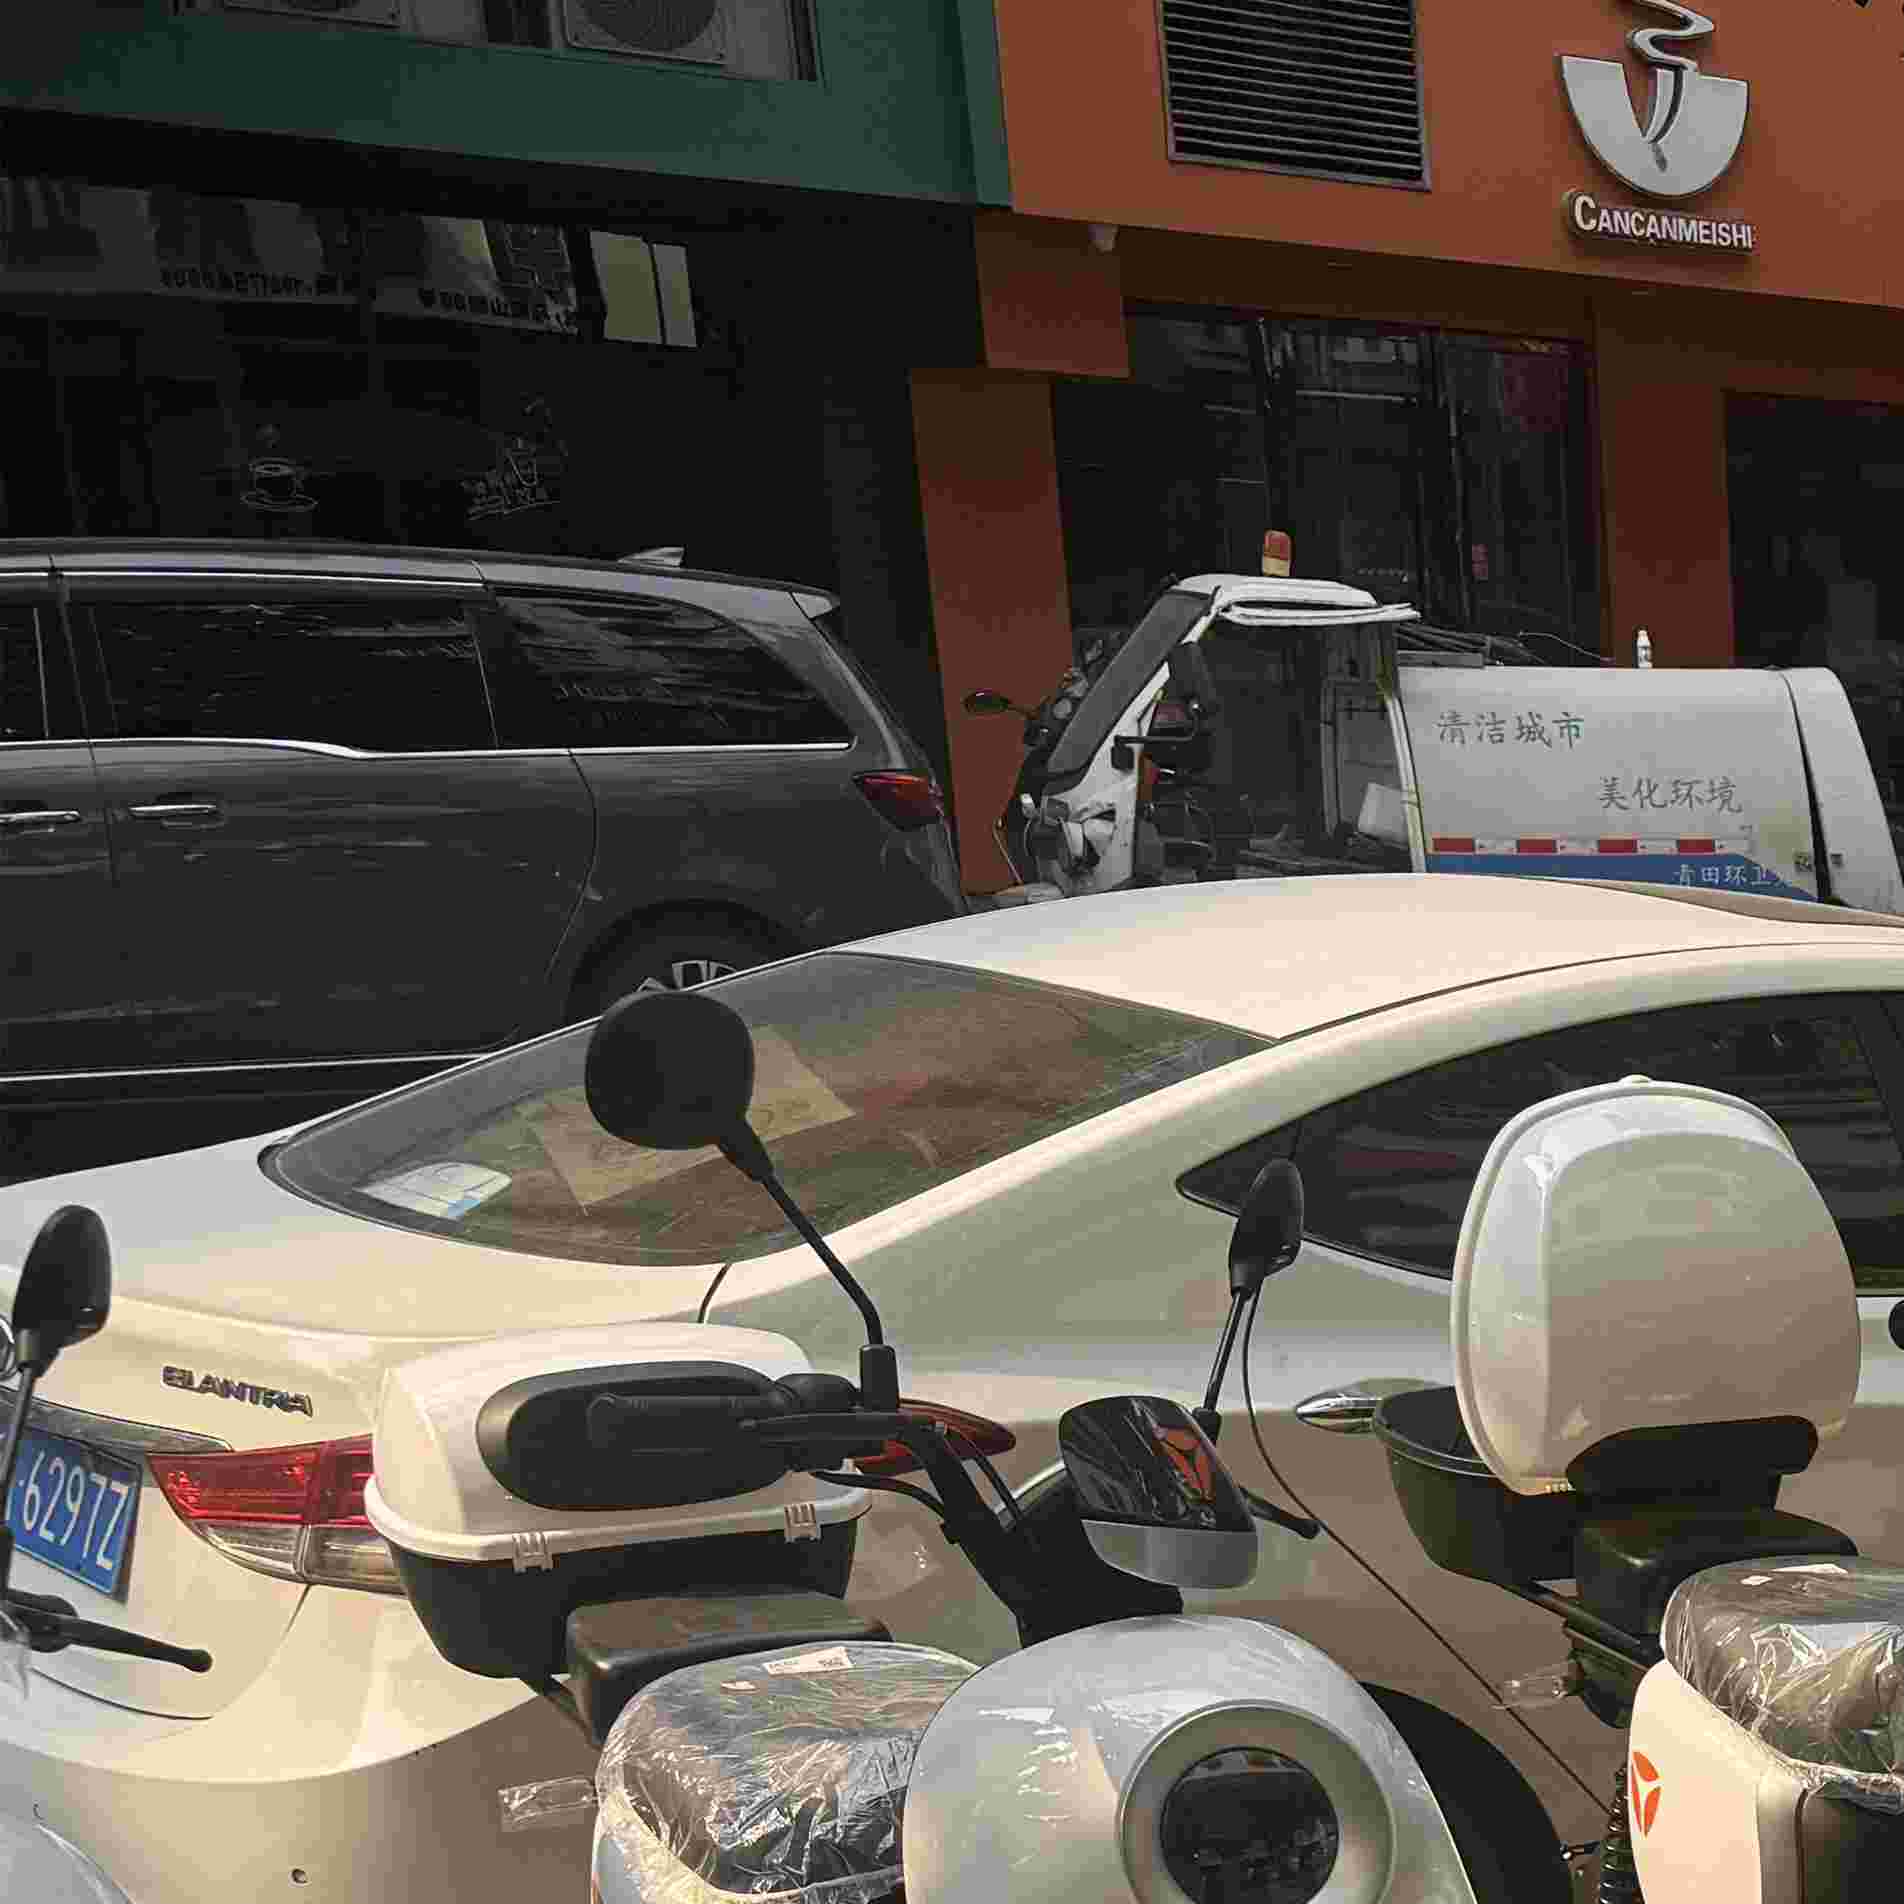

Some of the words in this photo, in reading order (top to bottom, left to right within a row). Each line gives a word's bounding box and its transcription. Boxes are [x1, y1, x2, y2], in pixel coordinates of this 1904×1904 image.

[1574, 193, 1753, 249] CANCANMEISHI
[1434, 709, 1585, 750] 清洁城市
[1596, 775, 1744, 815] 美化环境
[161, 1365, 314, 1418] ELANTRA
